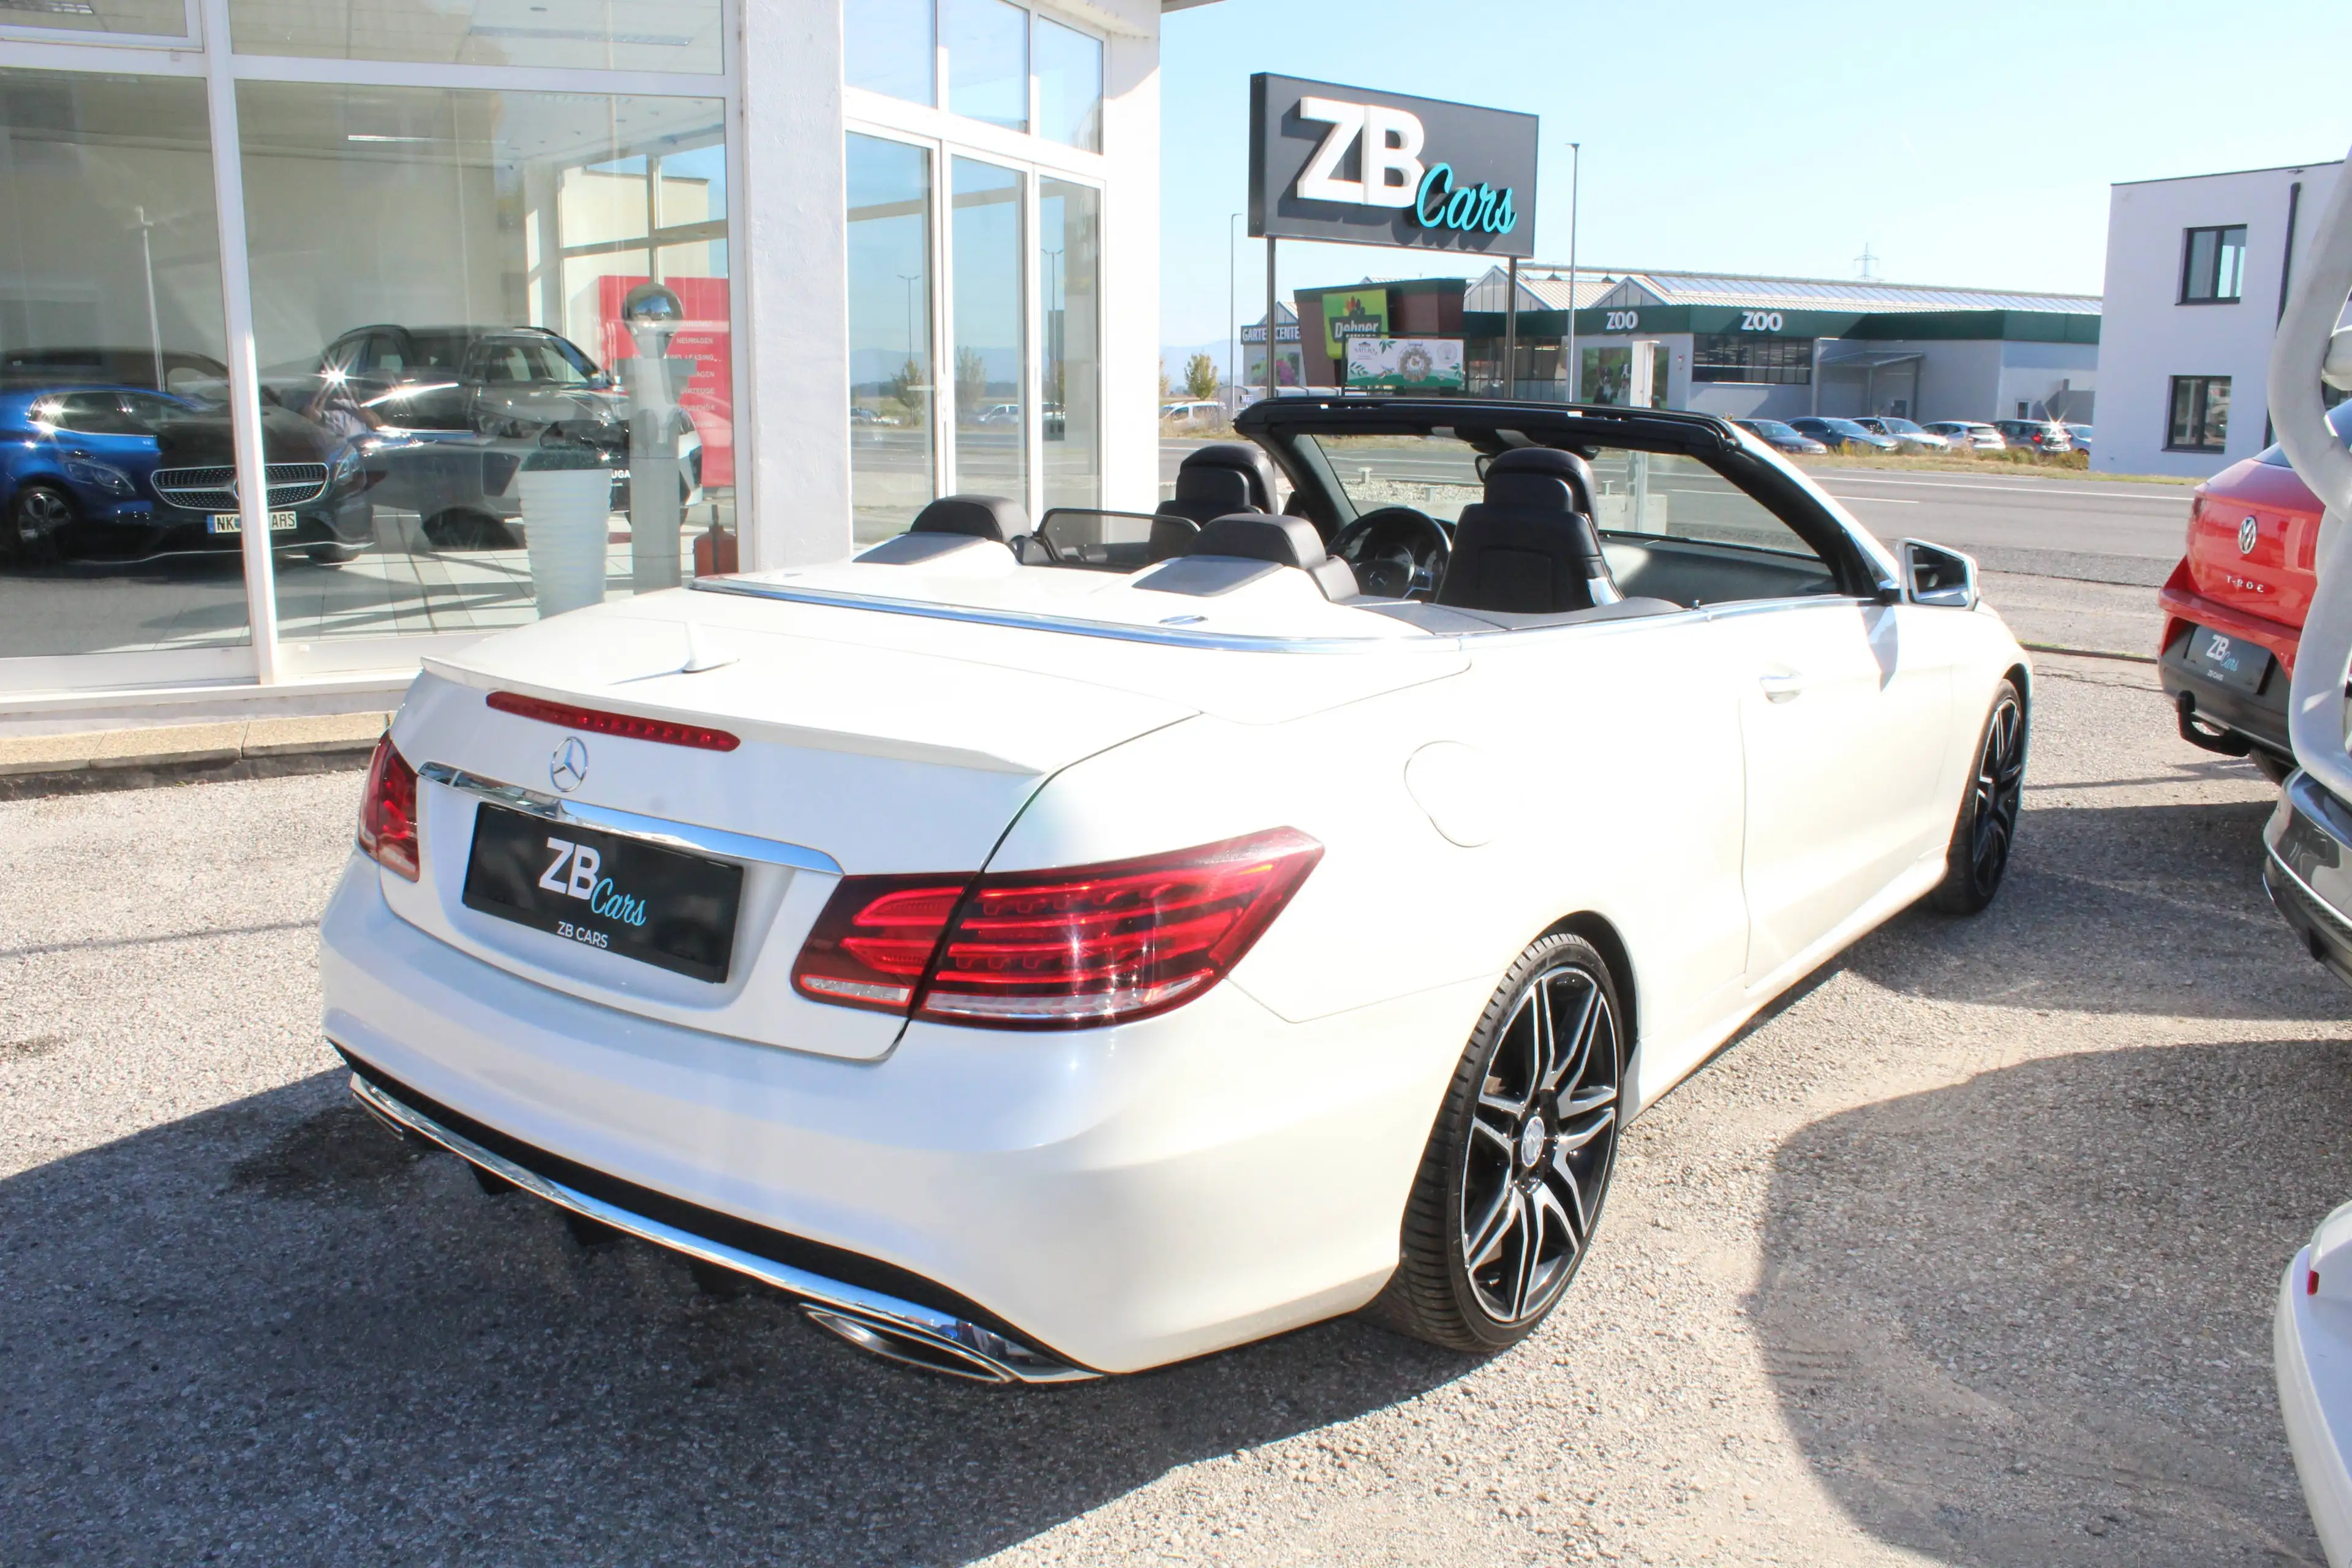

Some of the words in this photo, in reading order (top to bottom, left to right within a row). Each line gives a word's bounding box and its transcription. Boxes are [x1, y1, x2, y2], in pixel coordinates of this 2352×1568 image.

[1297, 96, 1425, 208] ZB
[1415, 162, 1517, 234] Cars
[1606, 311, 1639, 330] ZOO
[1741, 311, 1784, 331] ZOO
[1242, 328, 1267, 341] GARTE
[1275, 326, 1301, 340] CENTE
[216, 516, 235, 531] NK
[2226, 575, 2264, 593] T-ROC
[2206, 634, 2230, 661] ZB
[2220, 651, 2239, 671] Cars
[538, 837, 600, 900] ZB
[591, 877, 646, 926] Cars
[557, 921, 574, 938] ZB
[576, 927, 609, 949] CARS
